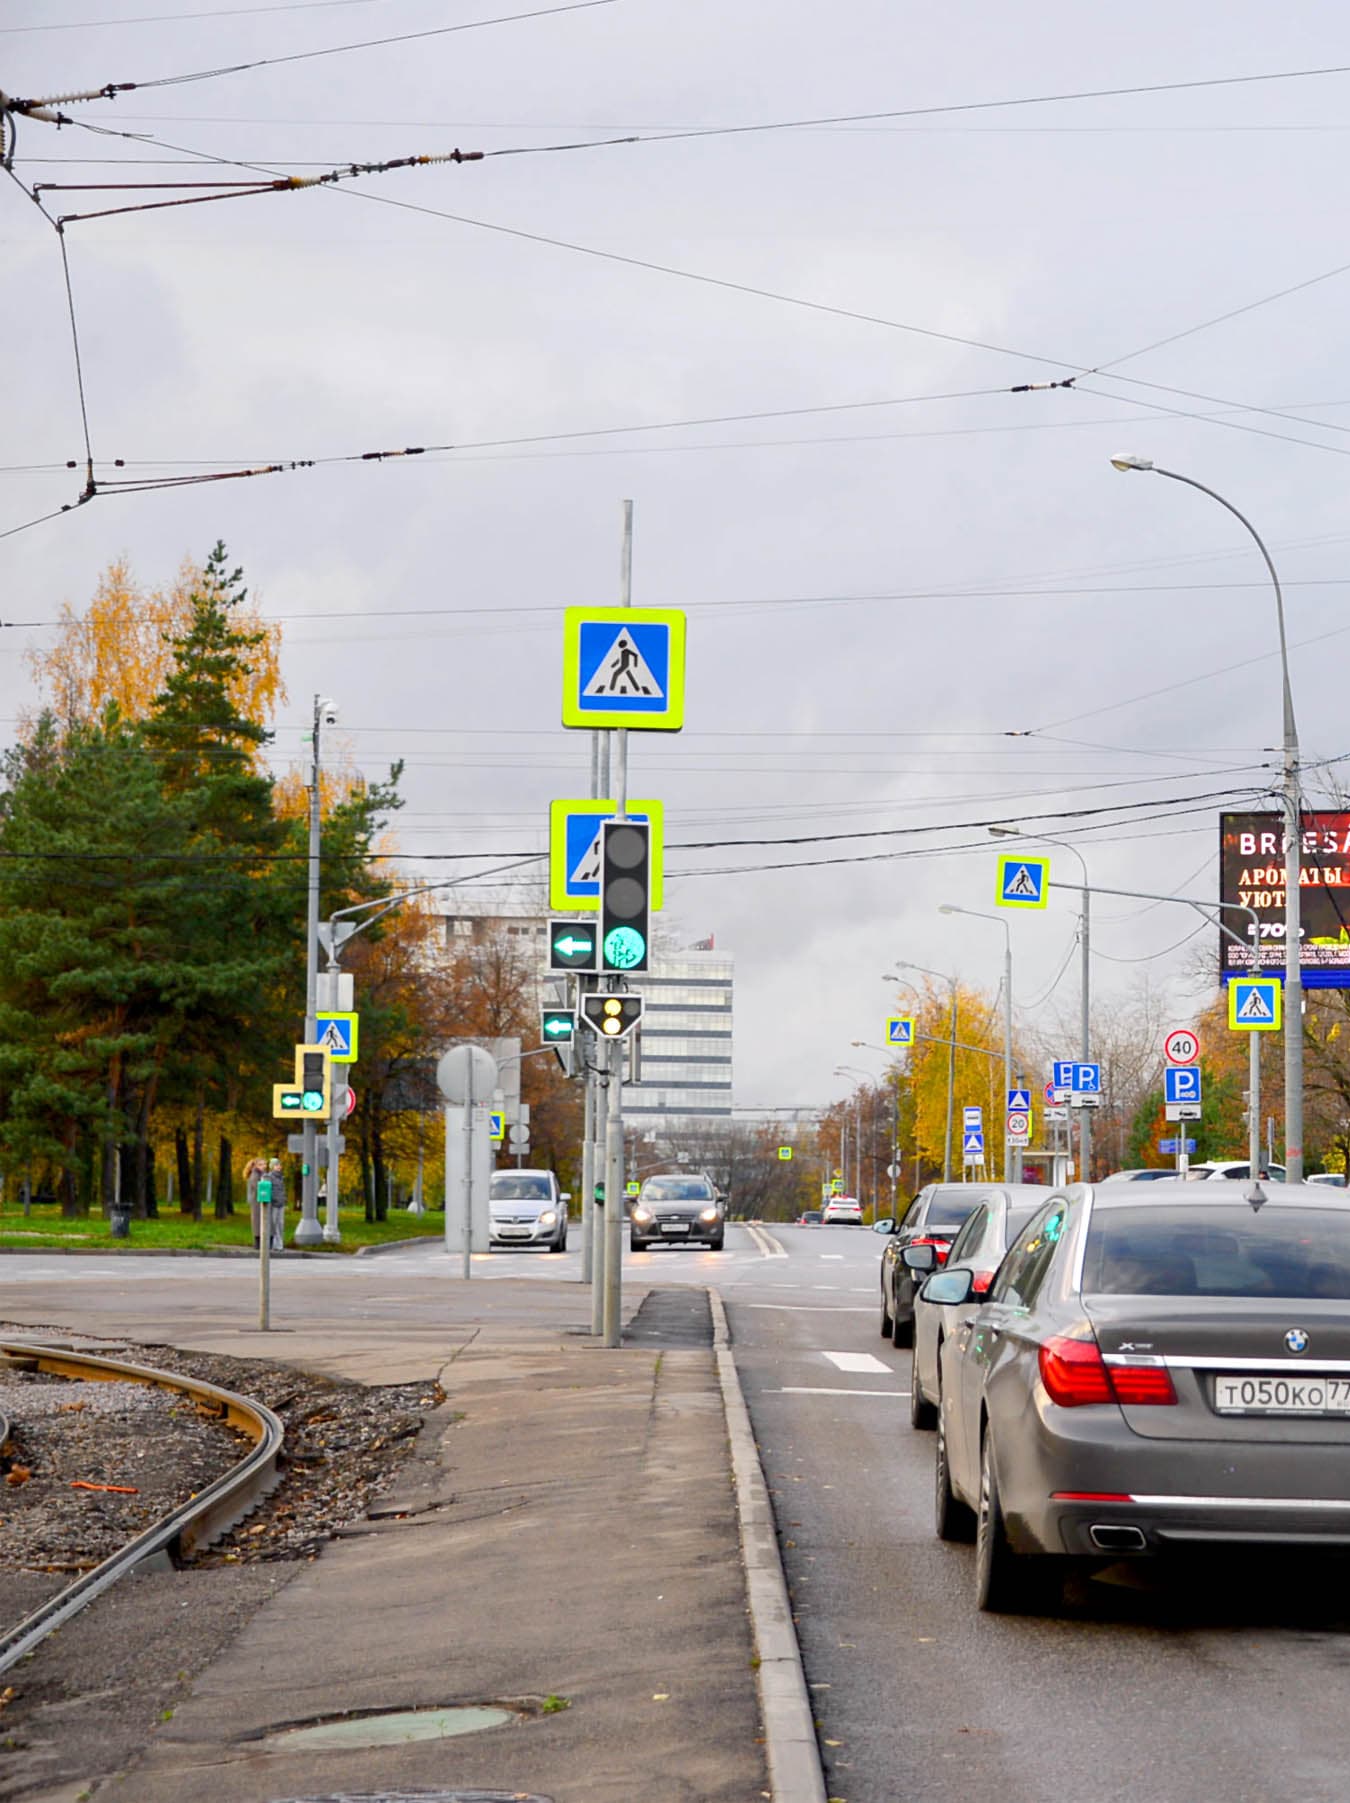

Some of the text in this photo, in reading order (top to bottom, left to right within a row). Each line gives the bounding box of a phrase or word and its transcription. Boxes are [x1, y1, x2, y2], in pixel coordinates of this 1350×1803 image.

[1238, 890, 1288, 908] УЮТ
[1171, 1040, 1192, 1055] 40
[1175, 1071, 1194, 1099] P
[1011, 1119, 1025, 1129] 20
